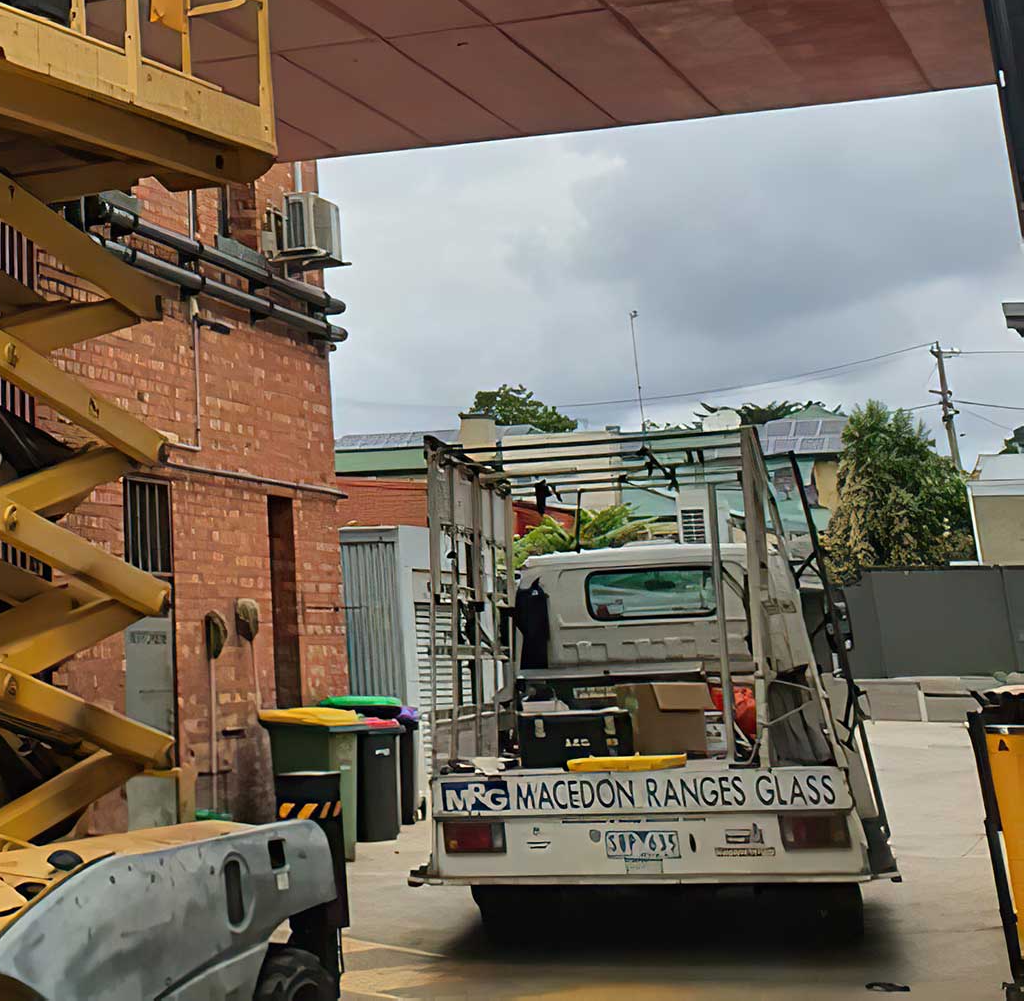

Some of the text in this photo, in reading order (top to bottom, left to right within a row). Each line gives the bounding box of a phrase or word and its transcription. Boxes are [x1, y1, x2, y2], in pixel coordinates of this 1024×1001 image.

[516, 774, 836, 810] MACEDON RANGES GLASS
